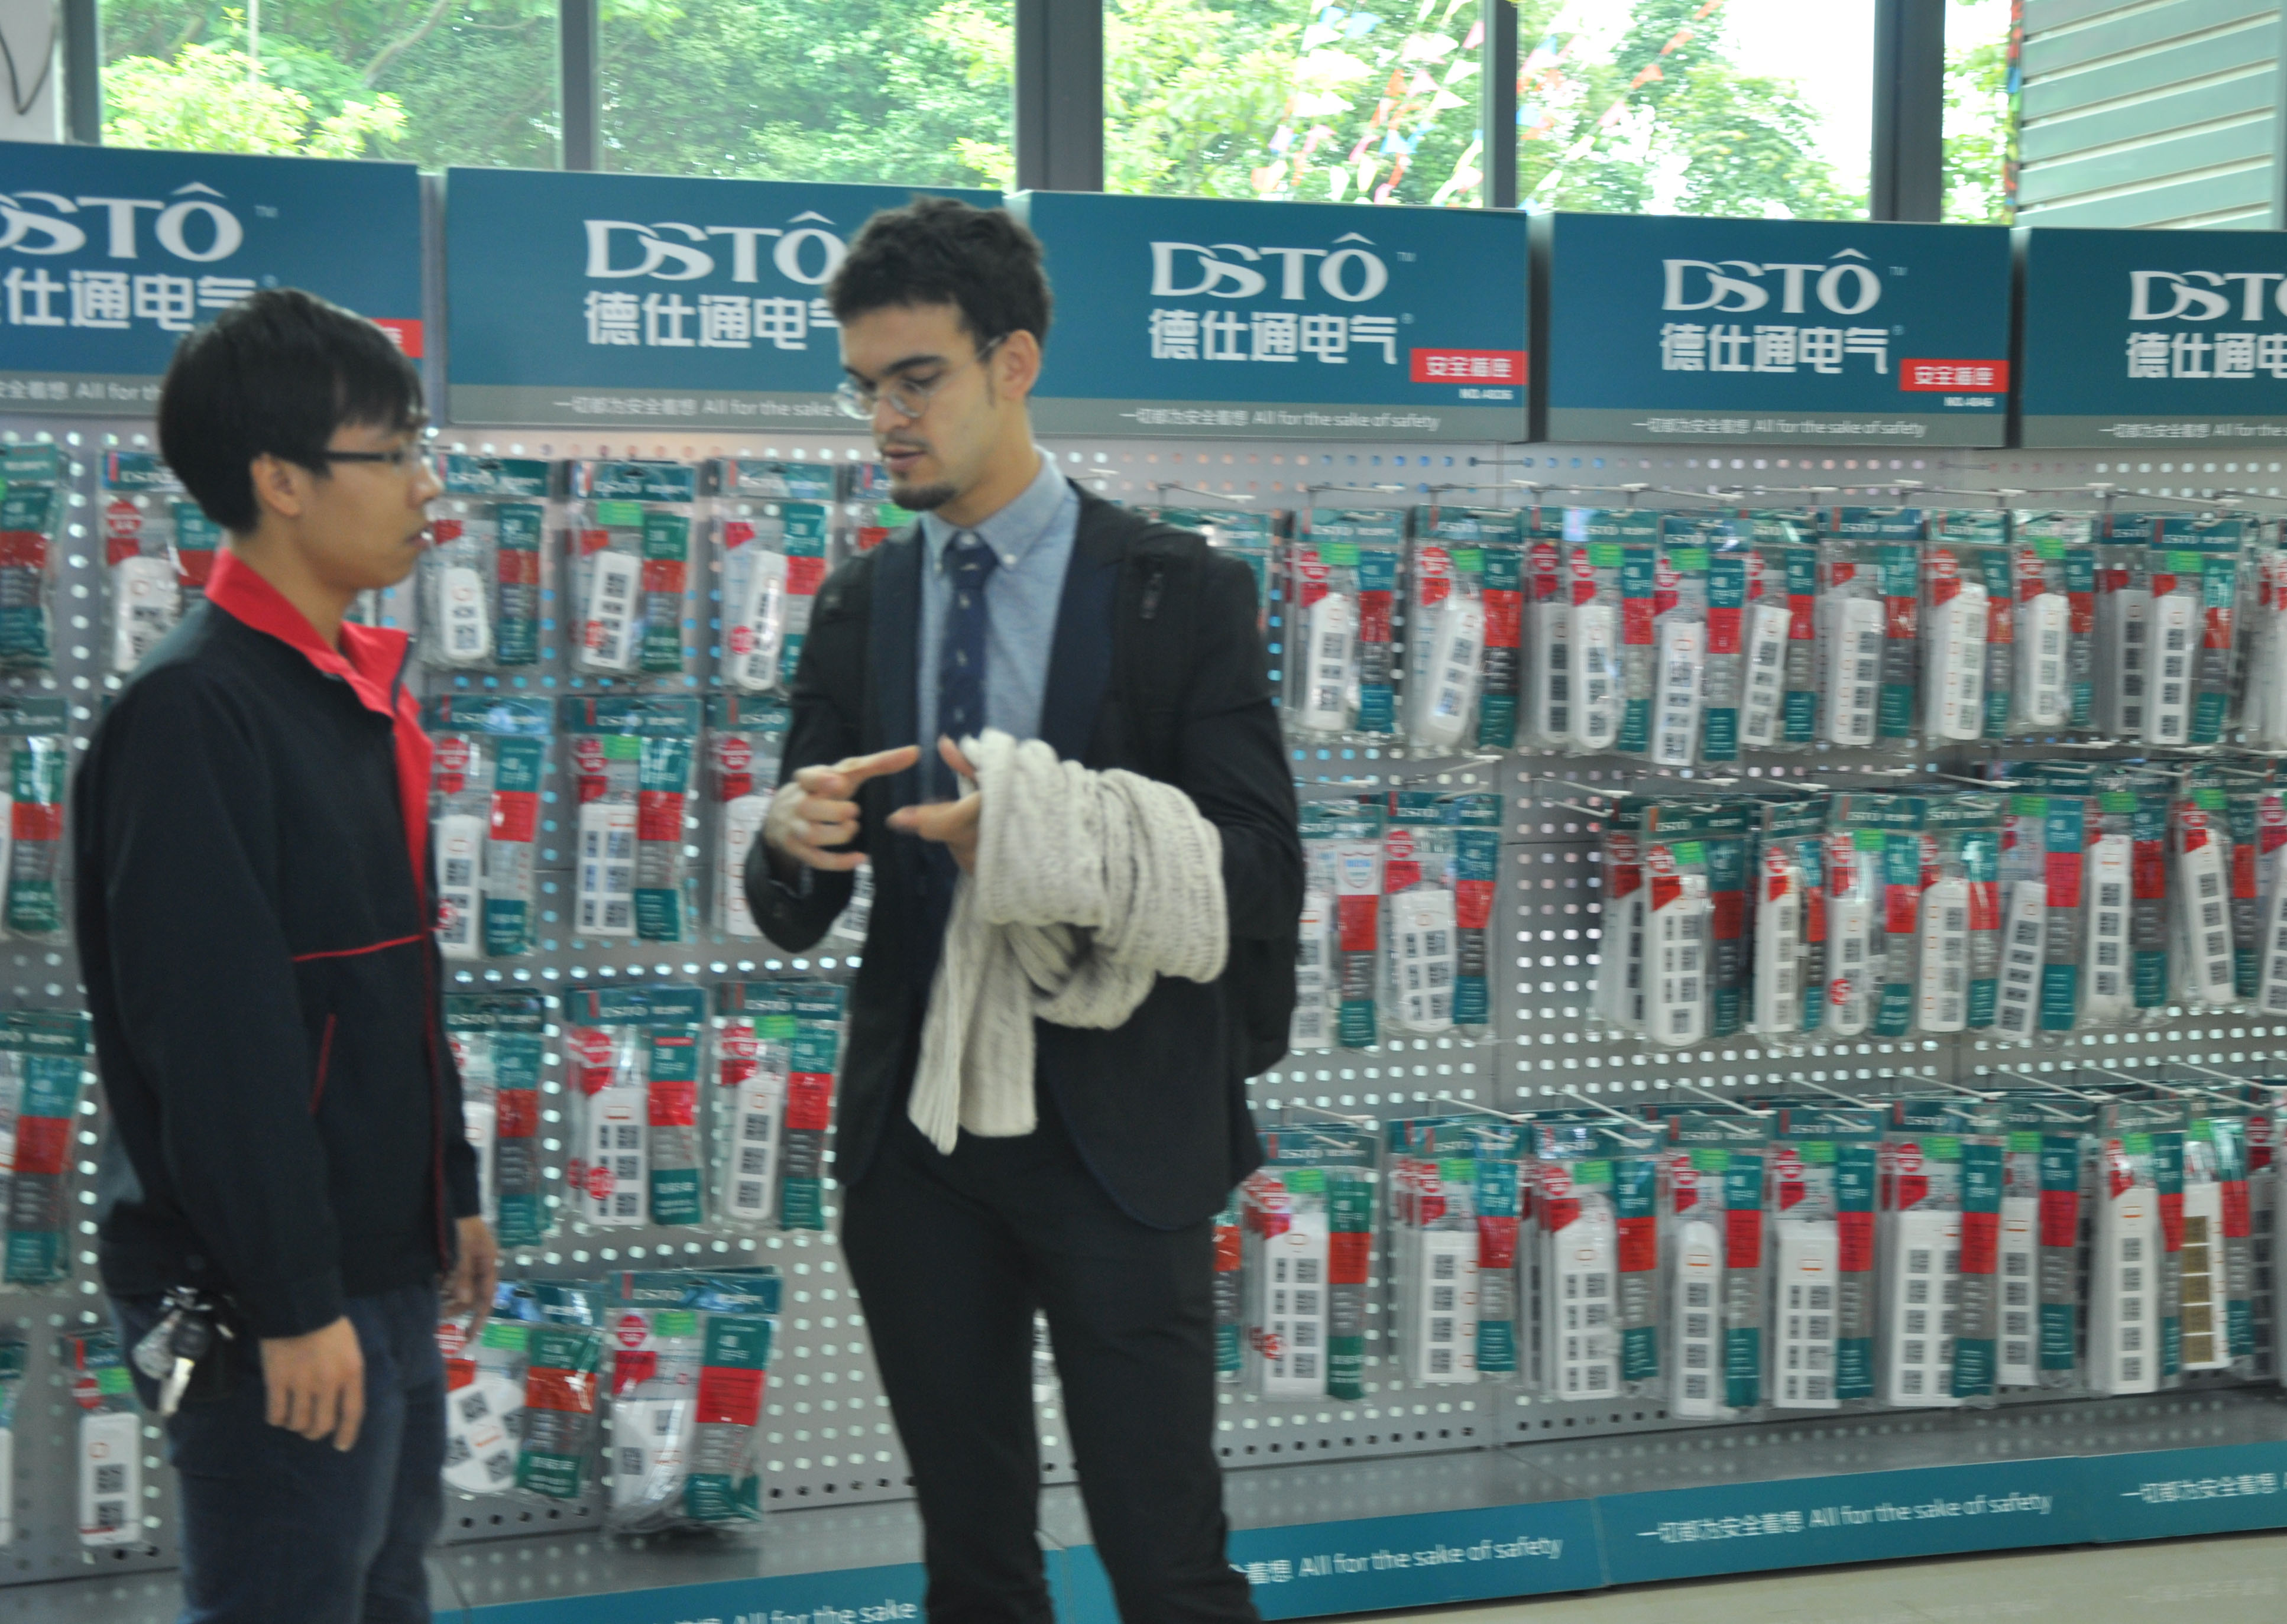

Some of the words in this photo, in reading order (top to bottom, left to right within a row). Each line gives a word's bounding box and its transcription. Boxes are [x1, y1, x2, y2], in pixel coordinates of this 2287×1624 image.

[2128, 271, 2287, 321] DST
[1148, 309, 1398, 364] 德仕通电气
[1659, 323, 1889, 374] 德仕通电气
[1809, 1507, 1841, 1528] All
[1840, 1506, 1873, 1525] for
[1875, 1503, 1912, 1522] the
[1913, 1499, 1962, 1519] sake
[1987, 1492, 2053, 1515] safety
[1298, 1555, 1333, 1577] All
[1333, 1553, 1368, 1574] for
[1370, 1549, 1411, 1570] the
[1413, 1544, 1466, 1566] sake
[1466, 1539, 1493, 1561] of
[1493, 1536, 1564, 1560] safety
[813, 1605, 857, 1624] the
[859, 1599, 918, 1623] sake
